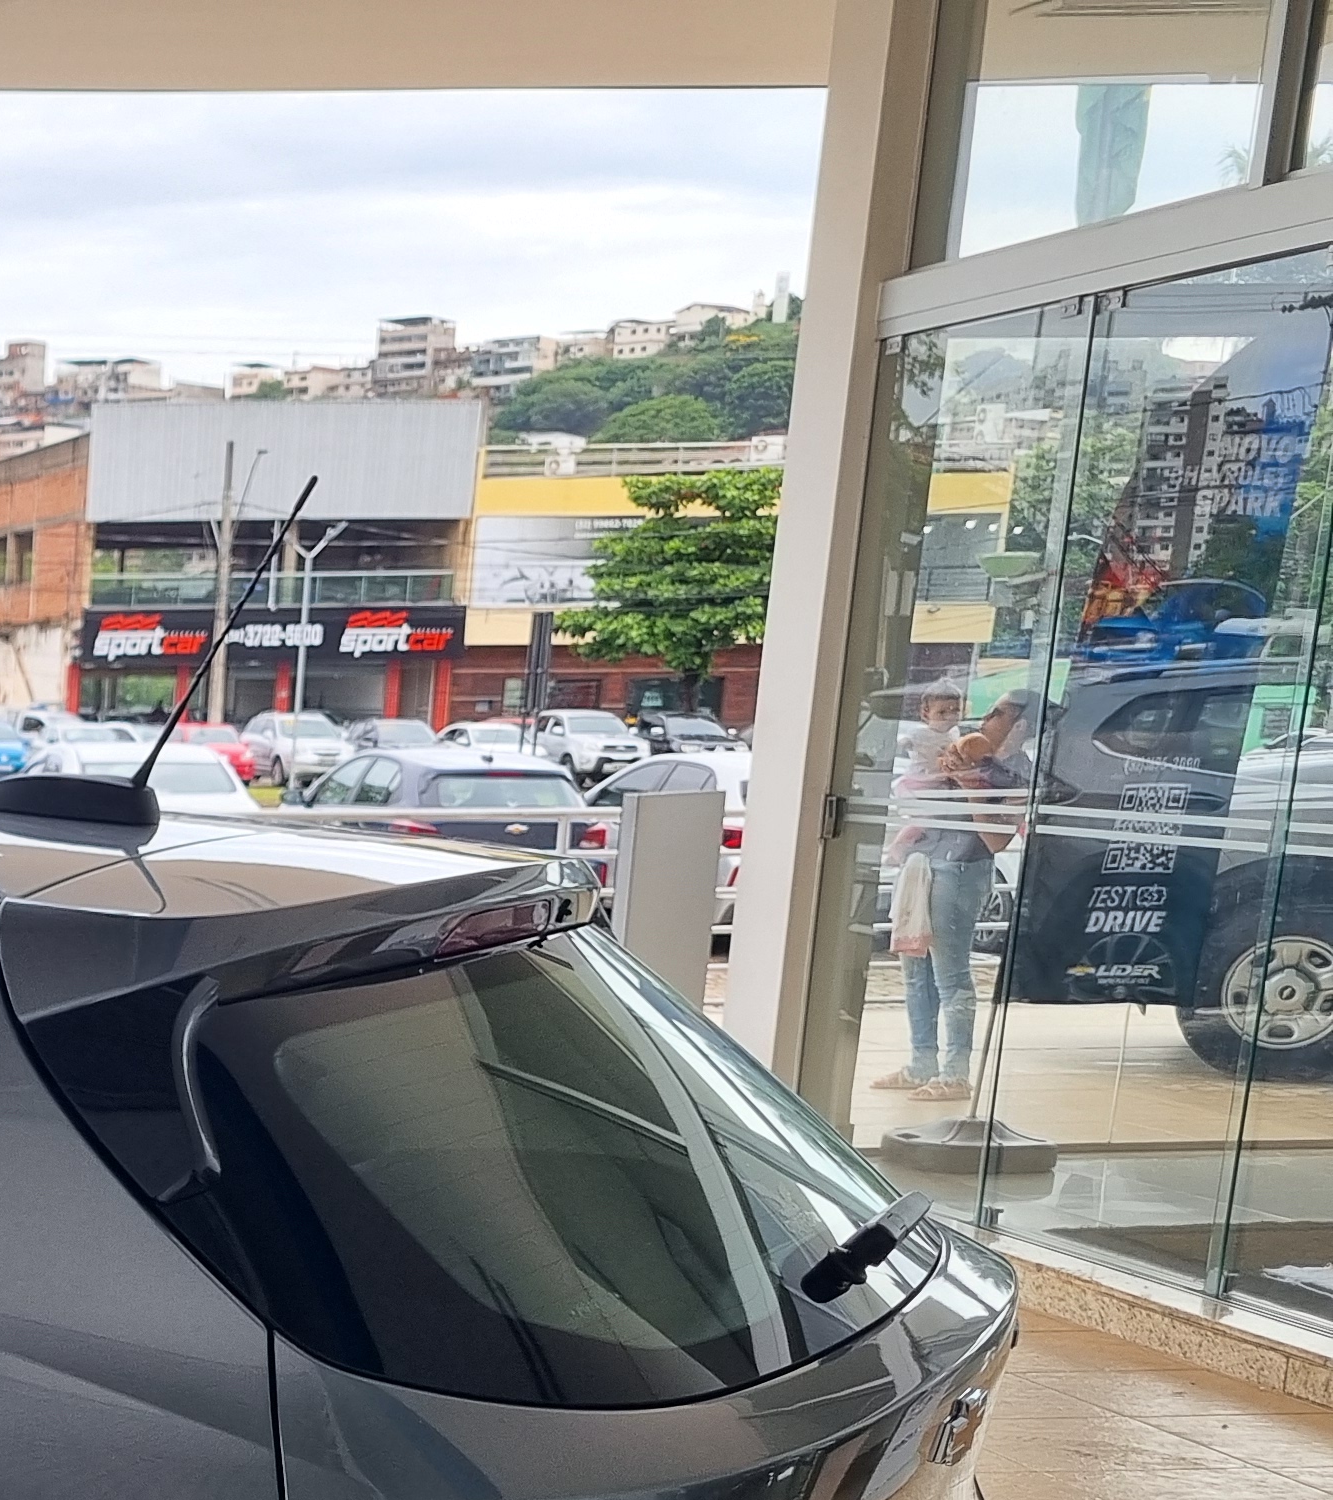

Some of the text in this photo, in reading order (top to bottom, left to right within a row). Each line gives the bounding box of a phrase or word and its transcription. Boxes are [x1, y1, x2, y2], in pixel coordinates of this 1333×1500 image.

[1194, 489, 1281, 518] SPARK
[1087, 886, 1136, 908] TEST
[1085, 910, 1167, 933] DRIVE
[1096, 964, 1162, 979] LIDER
